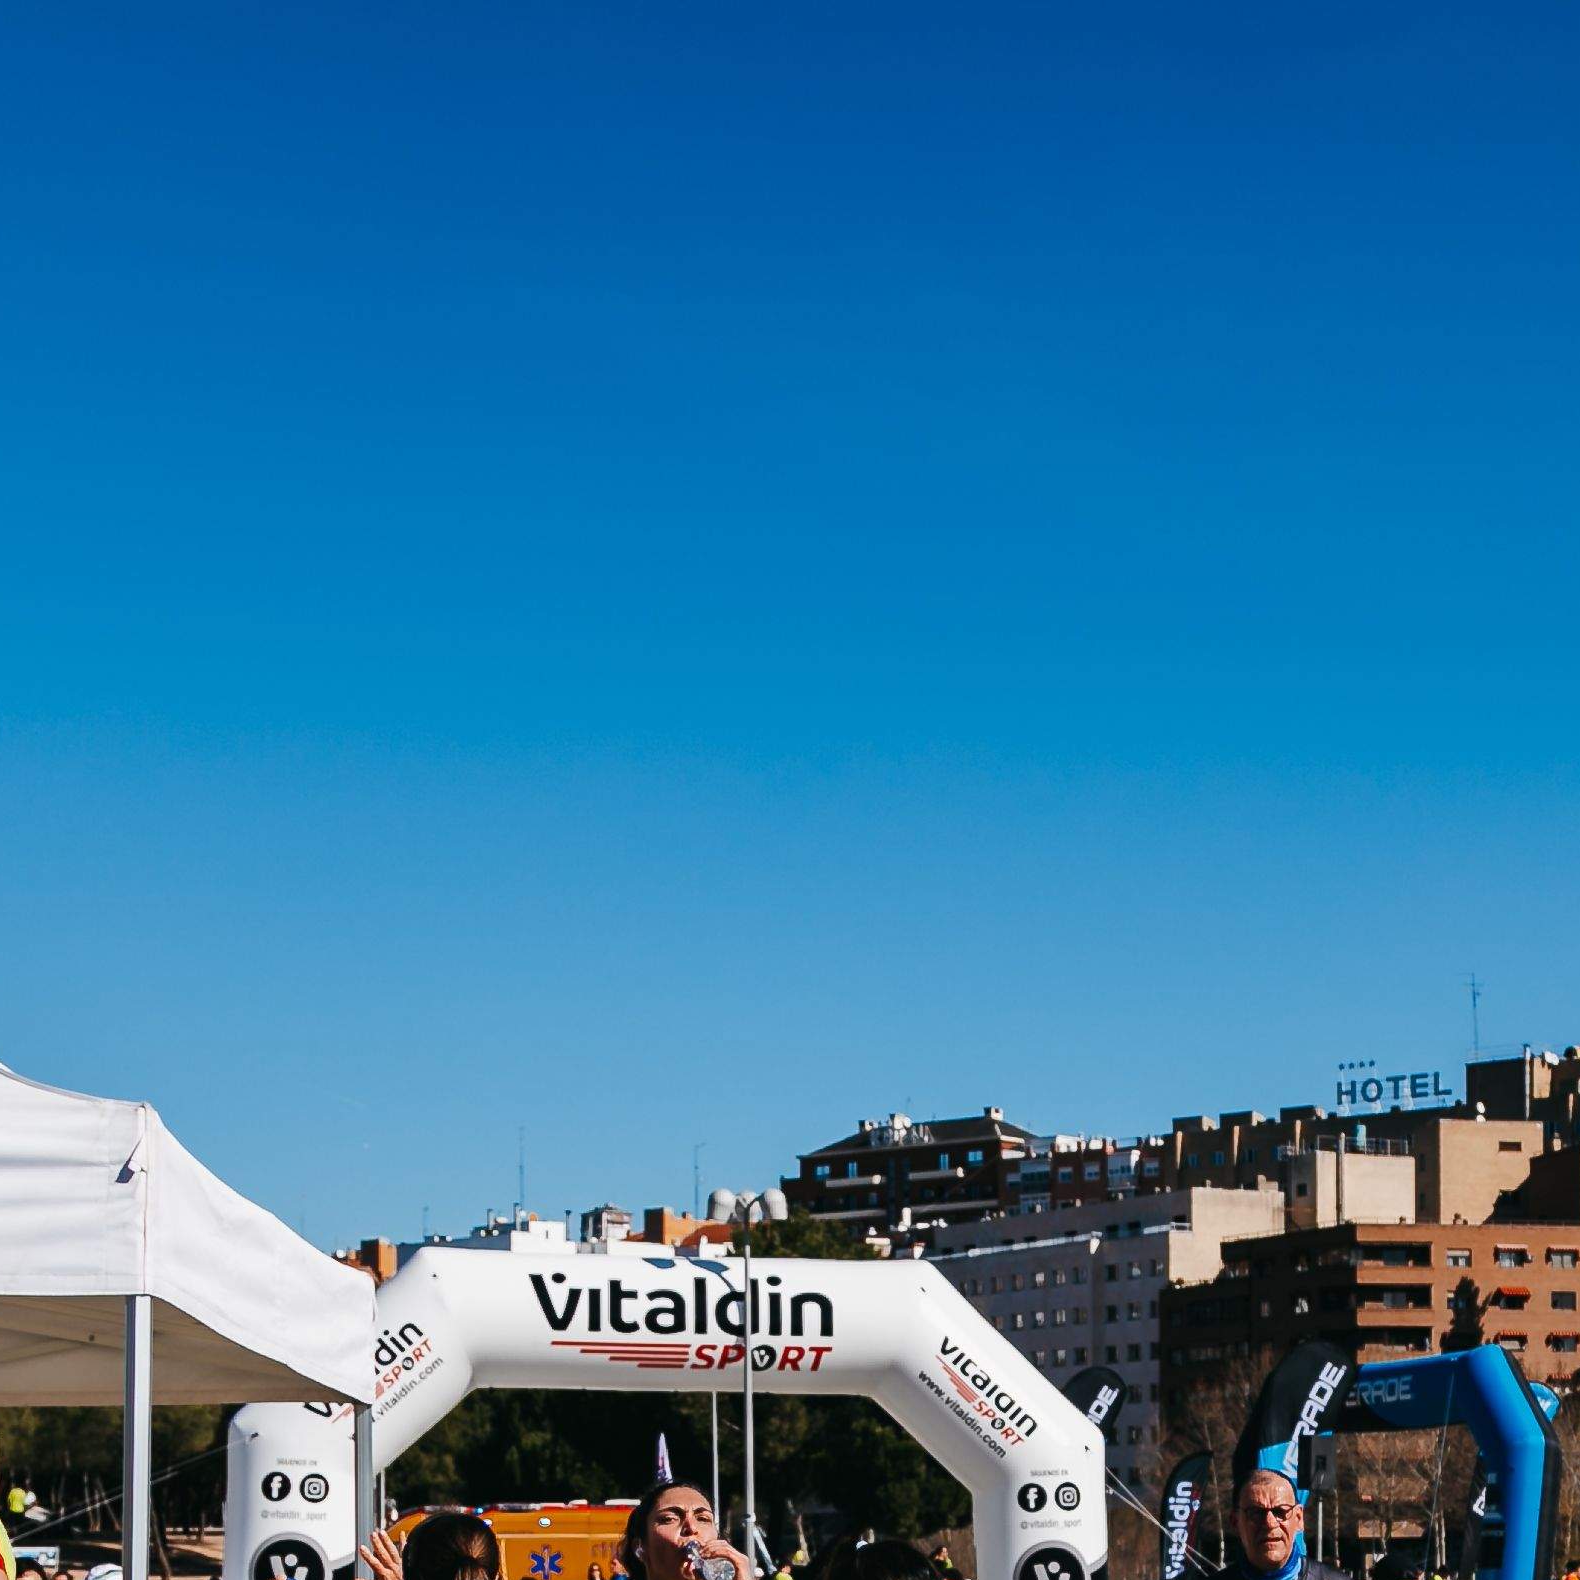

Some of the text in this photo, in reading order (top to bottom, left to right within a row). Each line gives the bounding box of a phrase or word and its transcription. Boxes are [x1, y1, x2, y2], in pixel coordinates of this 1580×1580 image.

[1337, 1071, 1452, 1105] HOTEL
[690, 1343, 833, 1372] SPORT
[919, 1370, 1007, 1459] www.vitaldin.com
[973, 1399, 1025, 1446] SPORT
